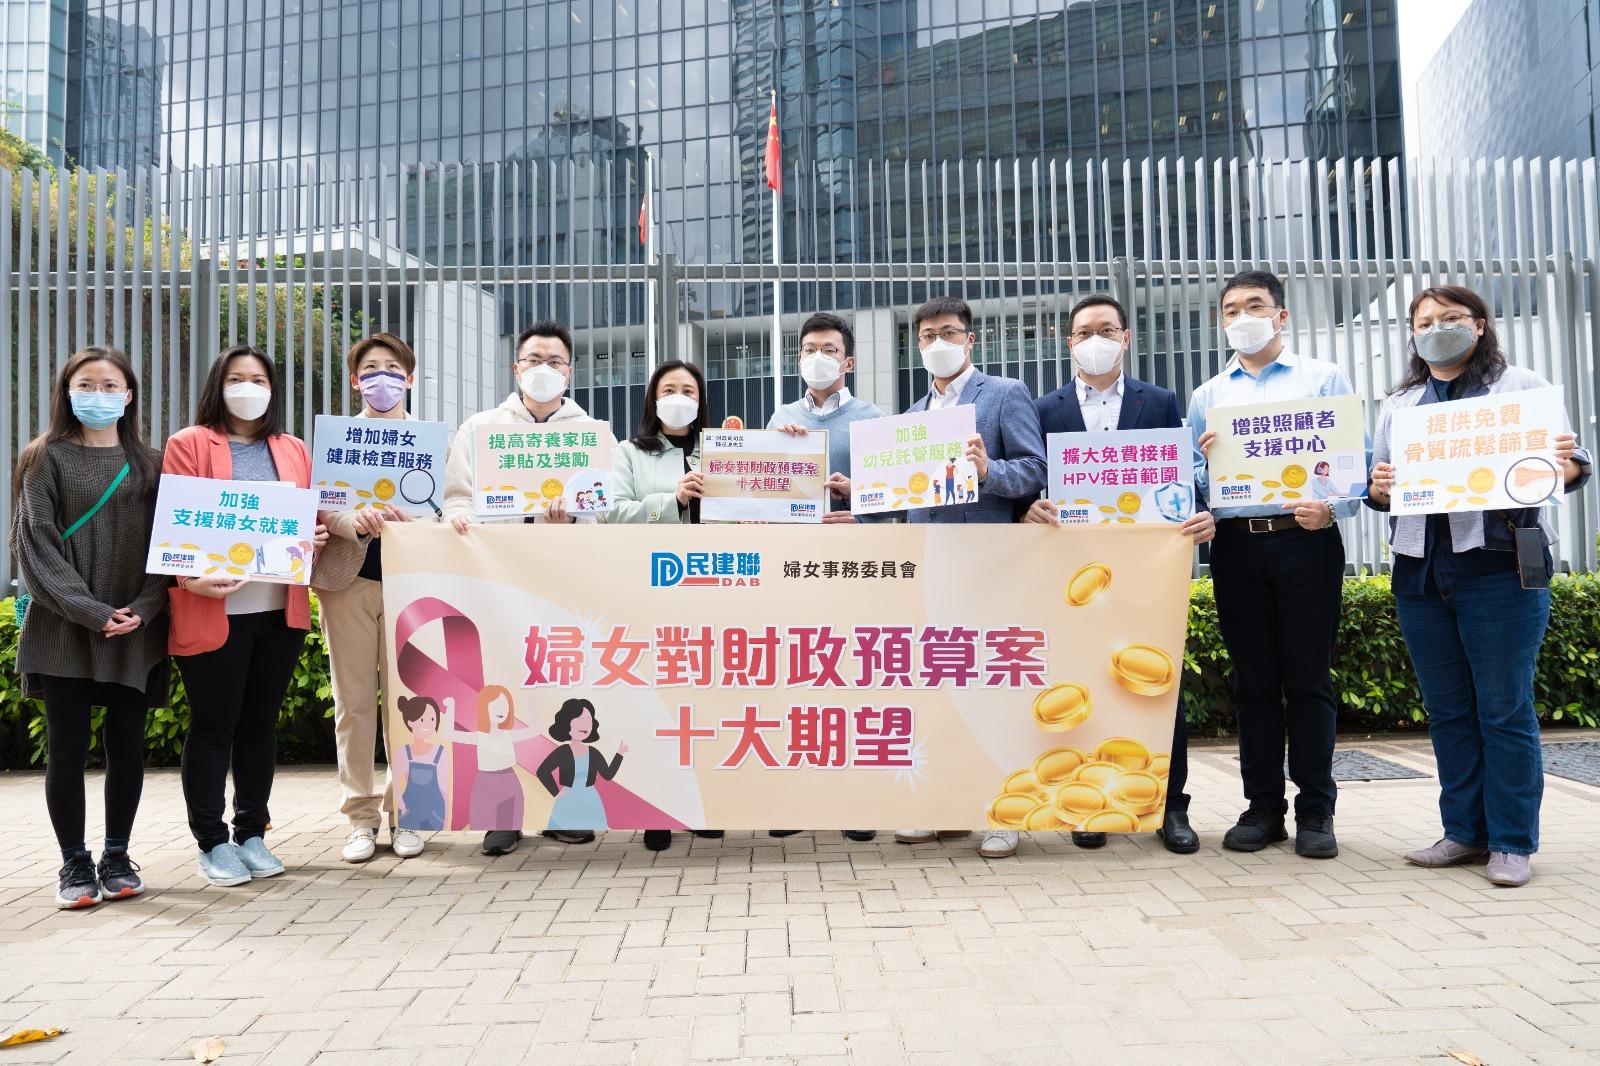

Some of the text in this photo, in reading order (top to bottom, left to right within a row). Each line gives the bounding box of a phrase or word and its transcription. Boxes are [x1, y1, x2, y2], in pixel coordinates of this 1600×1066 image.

[1232, 410, 1336, 436] 增設照顧者
[1426, 403, 1521, 435] 提供免費
[345, 426, 417, 447] 增加婦女
[488, 431, 598, 450] 提高寄養家庭
[895, 424, 928, 443] 加強
[863, 440, 963, 469] 幼兒託管服務
[1062, 443, 1179, 465] 擴大免費接種
[1243, 434, 1327, 459] 支援中心
[1404, 427, 1549, 464] 骨質疏鬆篩查
[326, 447, 433, 470] 健康檢查服務
[708, 459, 820, 476] 婦女對財政預算案
[736, 476, 791, 492] 十大期望
[1063, 466, 1179, 486] HPV疫苗範圍
[218, 490, 260, 511] 加強
[172, 508, 299, 536] 支援婦女就業
[686, 552, 761, 576] 民建聯
[783, 560, 917, 579] 婦女事務委員會
[722, 577, 760, 587] DAB
[522, 624, 1049, 689] 婦女對財政預算案
[654, 704, 915, 769] 十大期望
